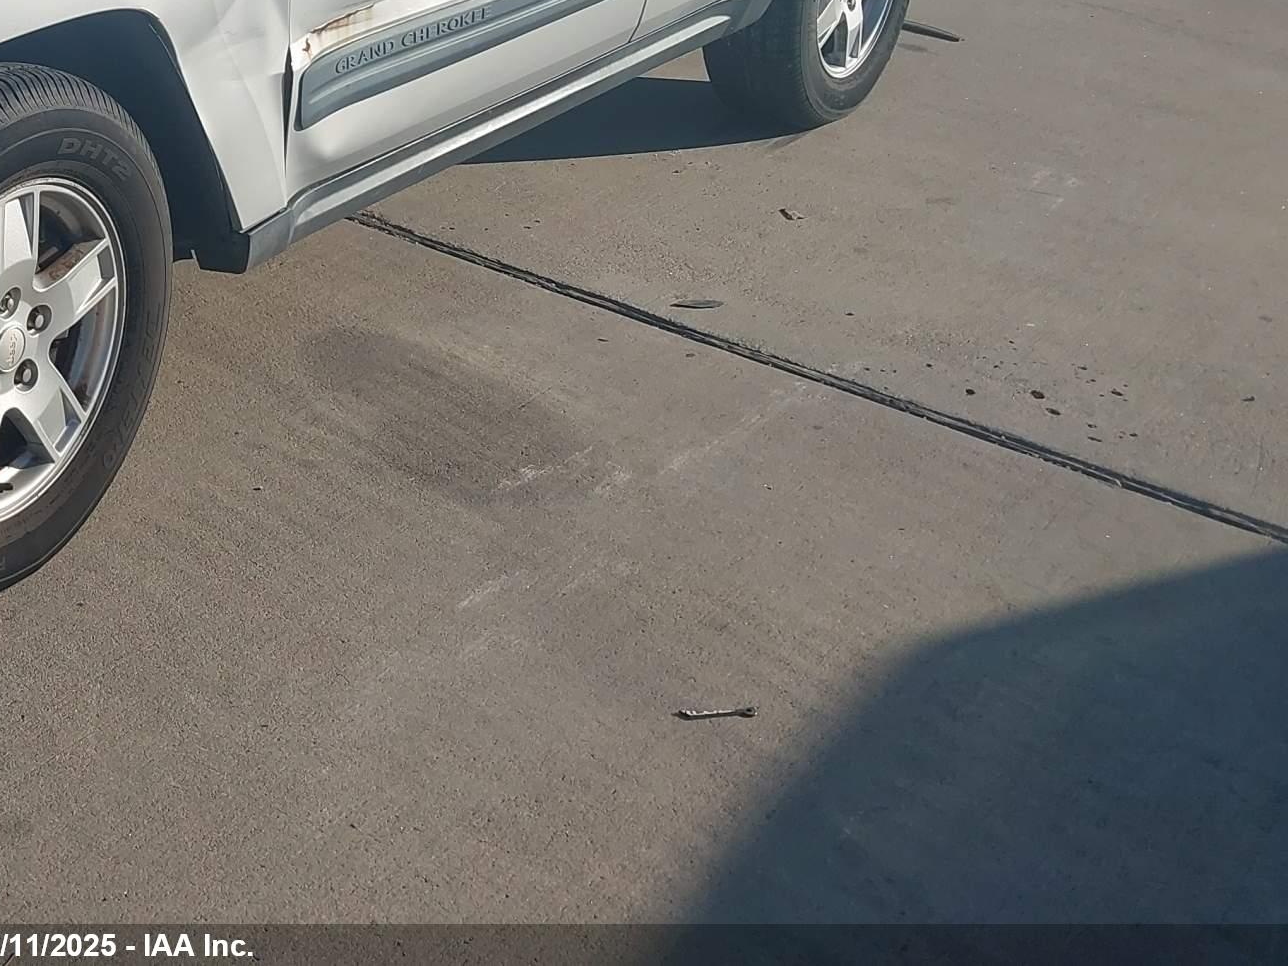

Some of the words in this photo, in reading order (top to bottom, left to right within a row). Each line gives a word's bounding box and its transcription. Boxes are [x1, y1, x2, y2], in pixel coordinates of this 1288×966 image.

[334, 40, 395, 74] GRAND
[400, 6, 492, 48] CHEROKEE
[56, 137, 133, 181] DHT2
